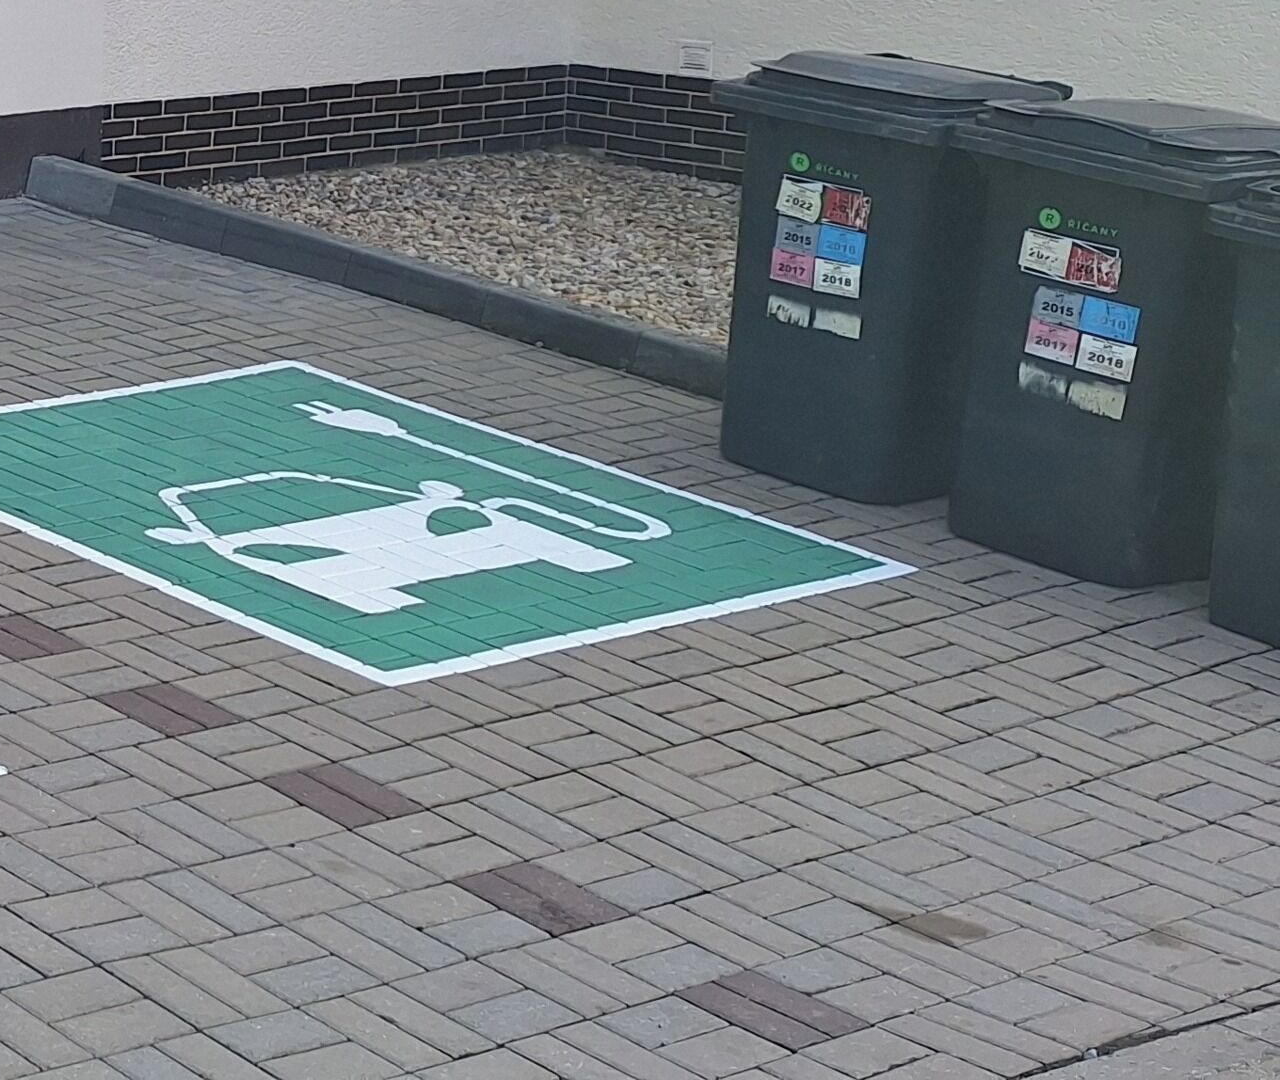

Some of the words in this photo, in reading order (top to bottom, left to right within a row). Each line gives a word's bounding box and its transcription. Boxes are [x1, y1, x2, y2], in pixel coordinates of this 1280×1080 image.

[783, 231, 812, 246] 2015
[778, 262, 806, 276] 2017
[821, 273, 852, 287] 2018
[1042, 301, 1074, 317] 2015
[1035, 335, 1067, 351] 2017
[1087, 351, 1124, 369] 2018
